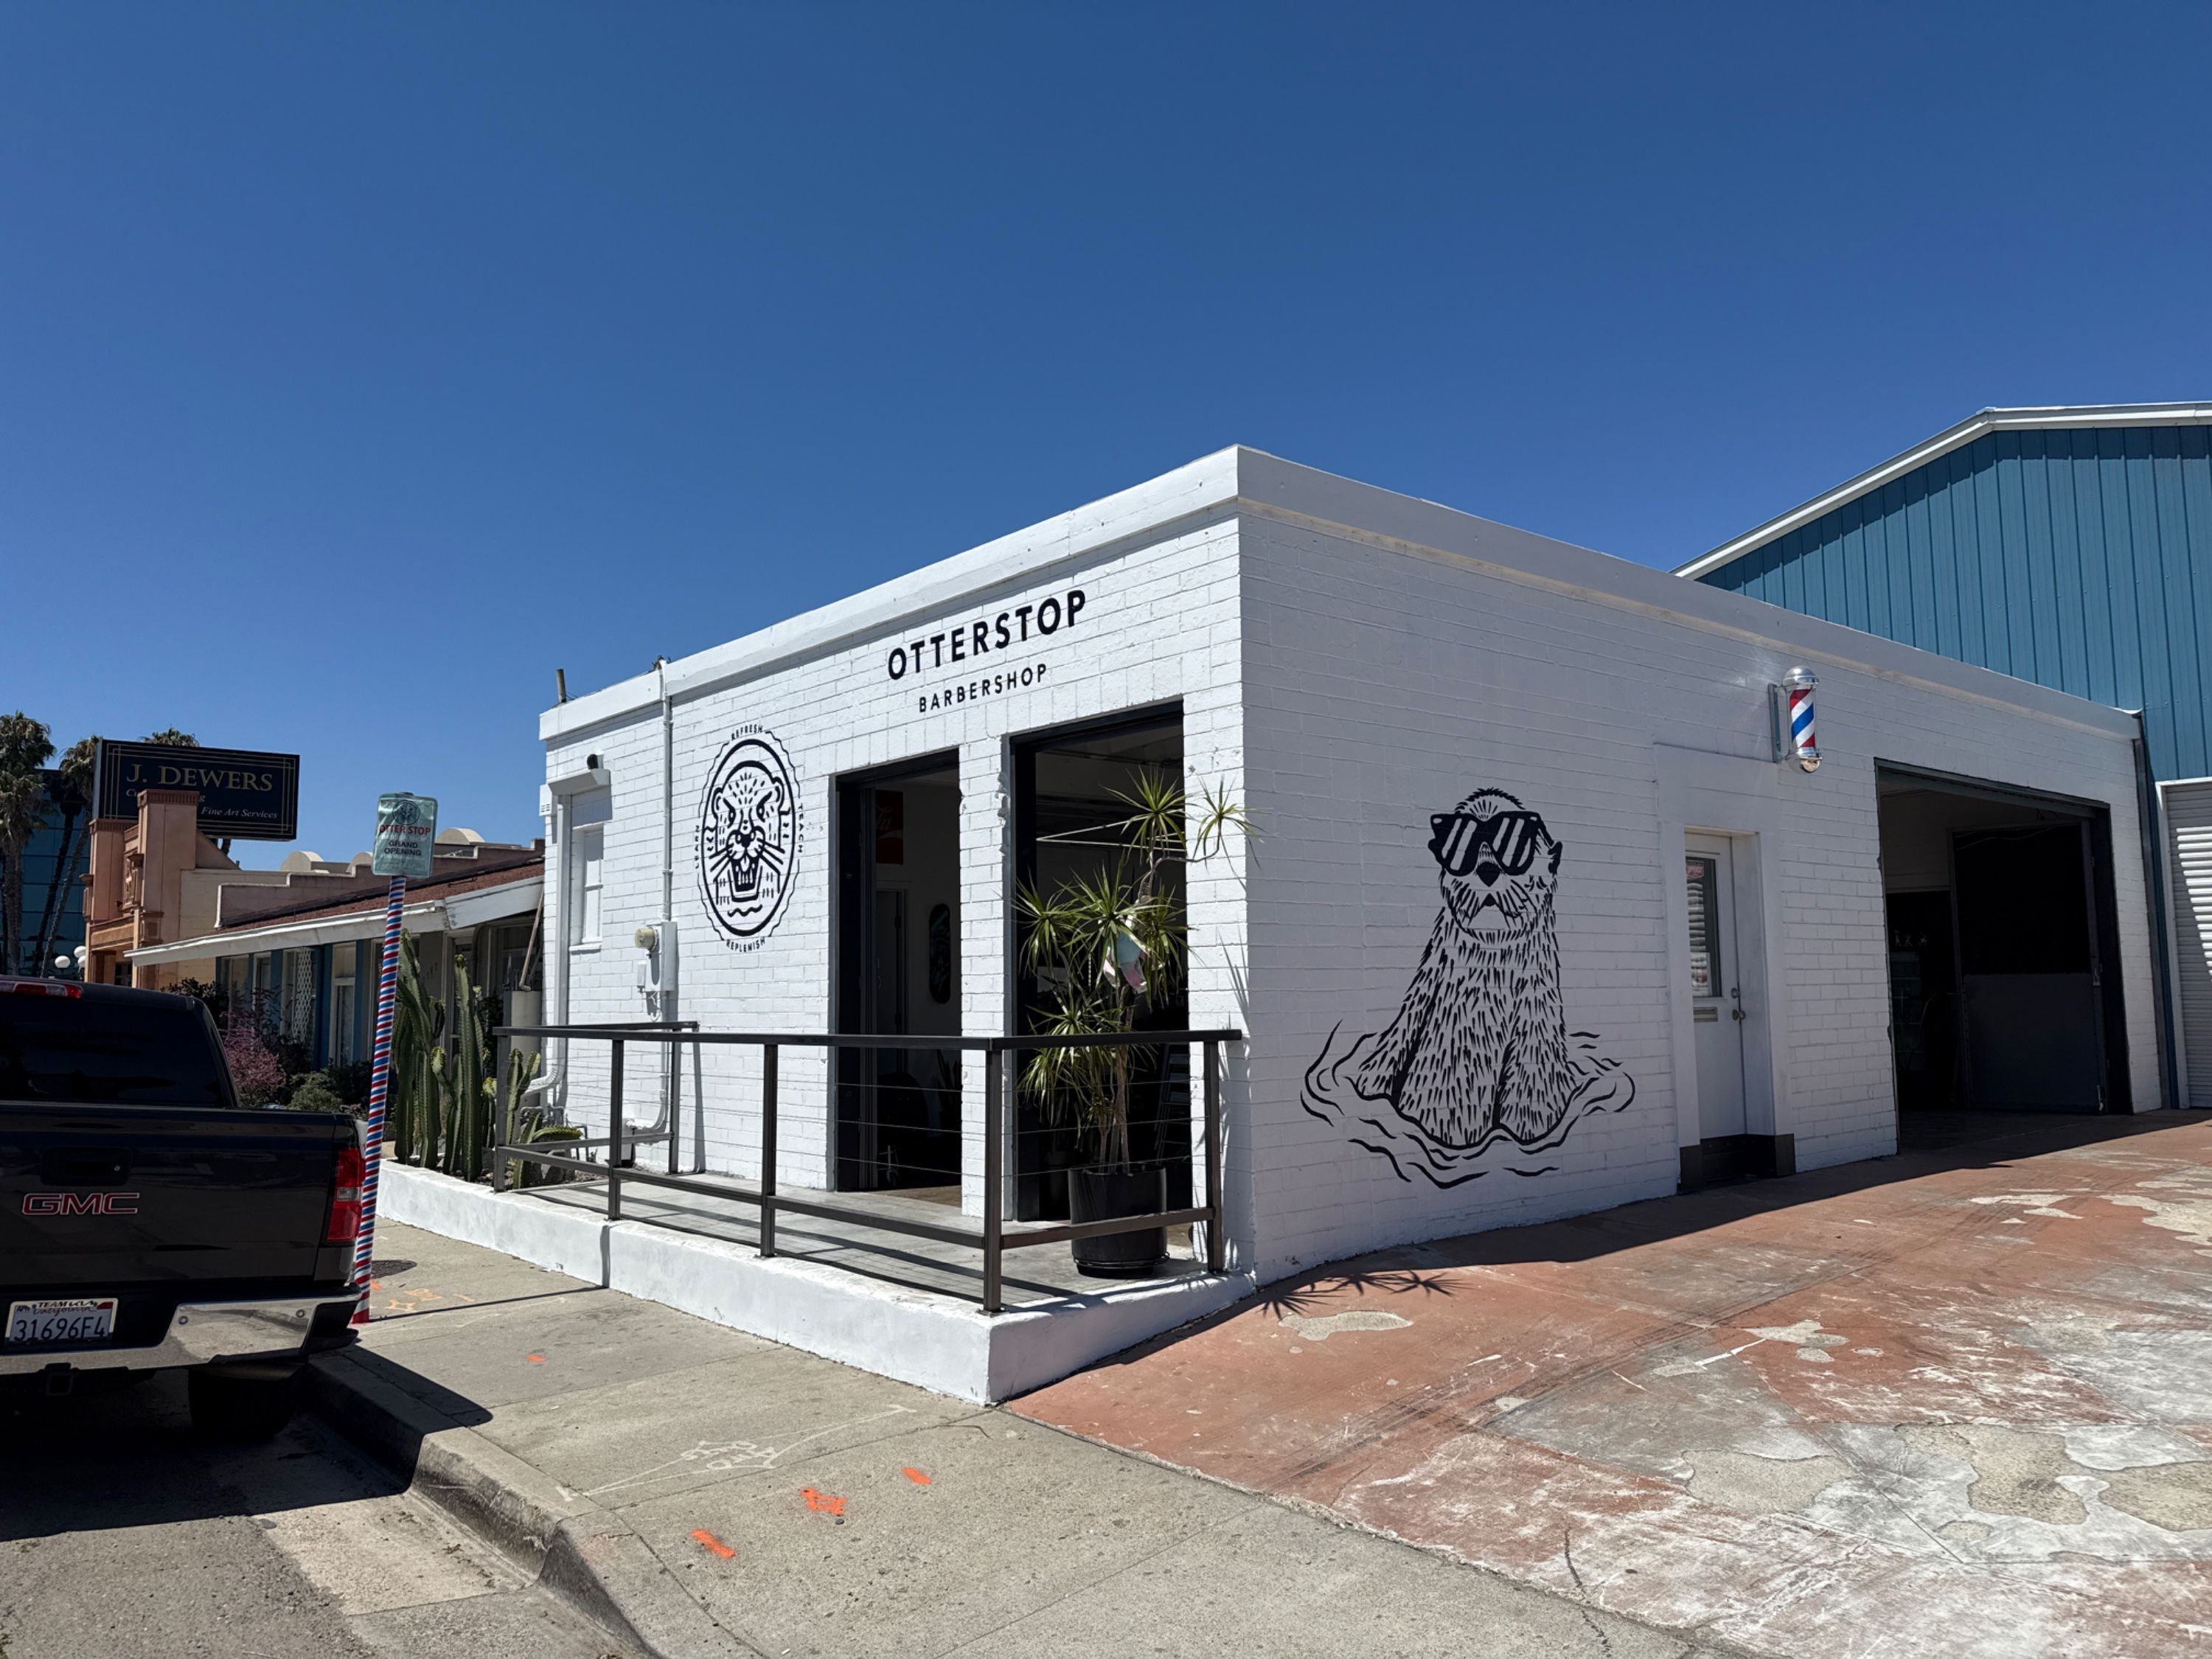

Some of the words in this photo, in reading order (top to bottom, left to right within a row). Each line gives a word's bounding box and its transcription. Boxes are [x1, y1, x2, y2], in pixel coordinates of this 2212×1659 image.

[888, 590, 1085, 680] OTTERSTOP
[919, 664, 1046, 713] BARBERSHOP
[731, 724, 762, 740] REFRESH
[126, 764, 147, 783] J.
[158, 766, 273, 791] DEWERS
[201, 807, 222, 816] Fine
[224, 808, 240, 816] Art
[240, 810, 278, 818] Services
[408, 827, 431, 835] STOP
[726, 936, 765, 953] REPLENISH
[22, 1192, 139, 1214] GMC
